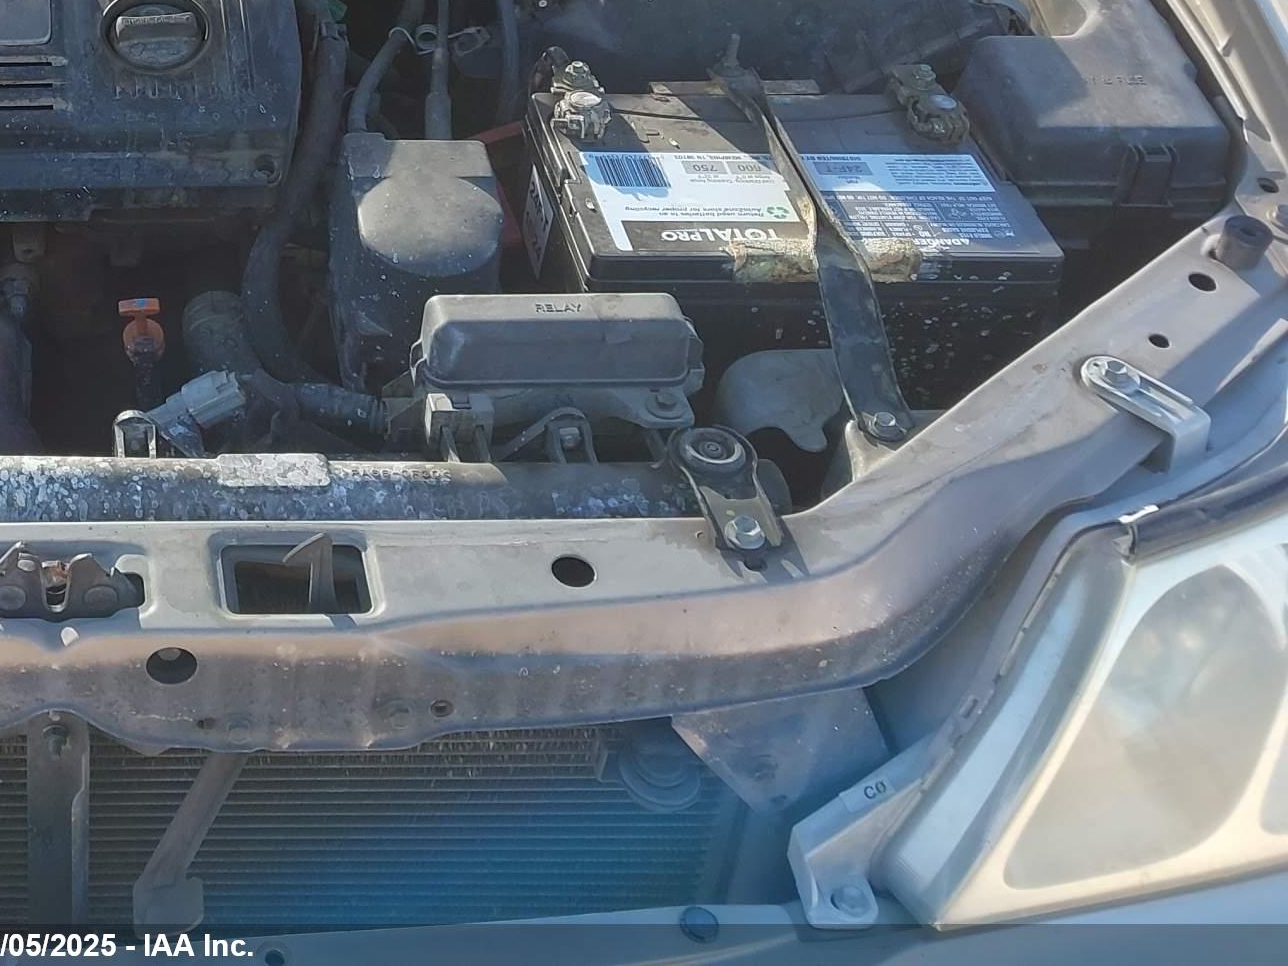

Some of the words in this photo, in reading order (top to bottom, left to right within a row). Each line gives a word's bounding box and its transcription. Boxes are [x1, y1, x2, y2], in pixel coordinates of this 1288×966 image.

[692, 164, 718, 172] 750
[660, 228, 783, 242] TOTALPRO
[534, 302, 582, 313] RELAY
